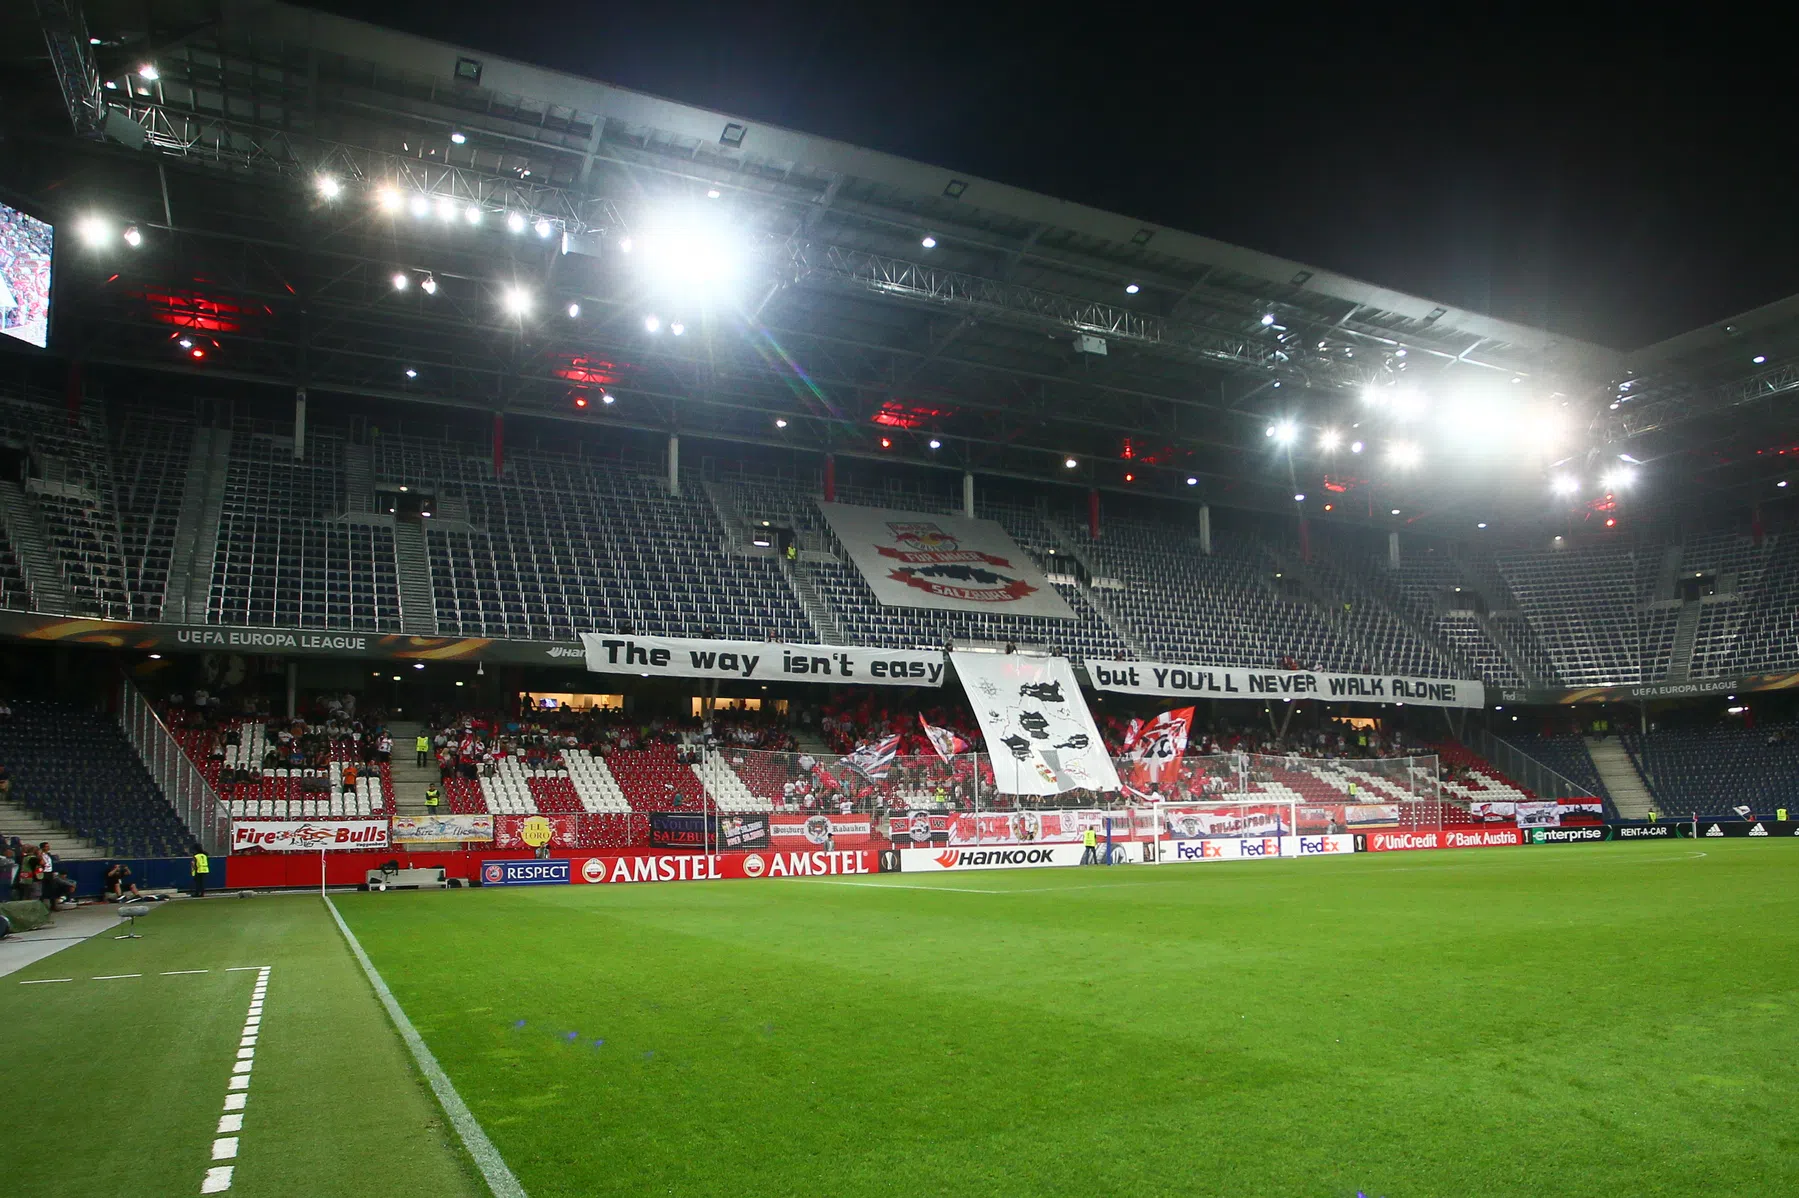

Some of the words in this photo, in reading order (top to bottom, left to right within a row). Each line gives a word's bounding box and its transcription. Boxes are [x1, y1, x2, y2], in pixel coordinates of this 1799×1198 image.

[935, 551, 984, 562] IMMER
[931, 584, 1012, 601] SALZBURG
[177, 630, 225, 644] UEFA
[229, 632, 297, 647] EUROPA
[301, 635, 366, 650] LEAGUE
[601, 639, 671, 667] The
[689, 650, 760, 678] way
[783, 650, 854, 677] isn't
[870, 659, 943, 683] easy
[1096, 665, 1140, 686] but
[1152, 667, 1239, 692] YOU'LL
[1249, 673, 1317, 693] NEVER
[1328, 677, 1384, 696] WALK
[1392, 678, 1456, 701] ALONE!
[1632, 686, 1658, 697] UEFA
[1659, 683, 1698, 695] EUROPA
[1700, 680, 1738, 692] LEAGUE
[235, 828, 276, 844] Fire
[334, 826, 387, 843] Bulls
[523, 831, 550, 839] TORO
[530, 823, 542, 831] EL
[1535, 828, 1602, 842] enterprise
[1621, 827, 1668, 837] RENT-A-CAR
[1300, 836, 1339, 853] FedEx
[1385, 833, 1438, 849] UniCredit
[1456, 831, 1482, 846] Bank
[1483, 830, 1517, 845] Austria
[1178, 840, 1222, 859] FedEx
[1240, 838, 1280, 857] FedEx
[507, 866, 569, 879] RESPECT
[609, 854, 722, 882] AMSTEL
[768, 851, 869, 877] AMSTEL
